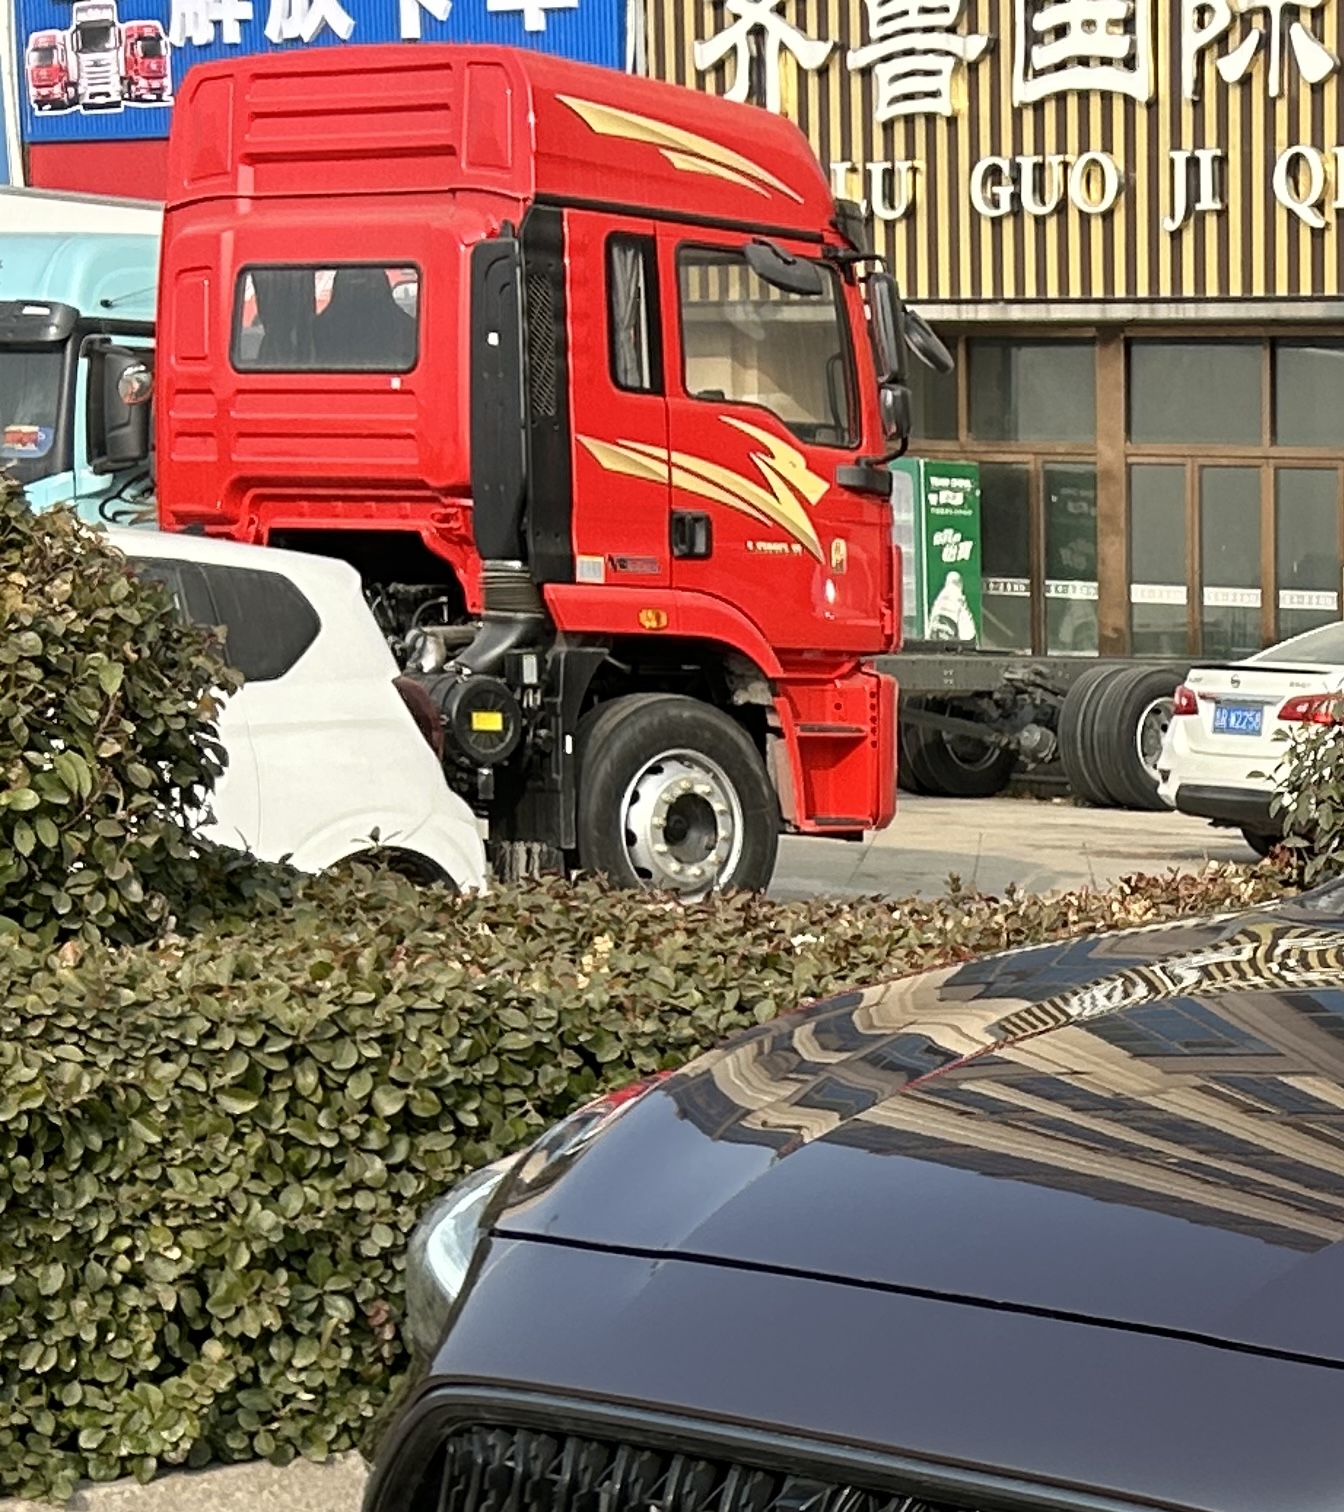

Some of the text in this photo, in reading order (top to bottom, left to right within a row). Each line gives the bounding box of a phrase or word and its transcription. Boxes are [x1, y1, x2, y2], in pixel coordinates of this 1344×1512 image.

[830, 159, 918, 220] LU
[970, 150, 1119, 217] GUO
[1163, 148, 1222, 231] JI
